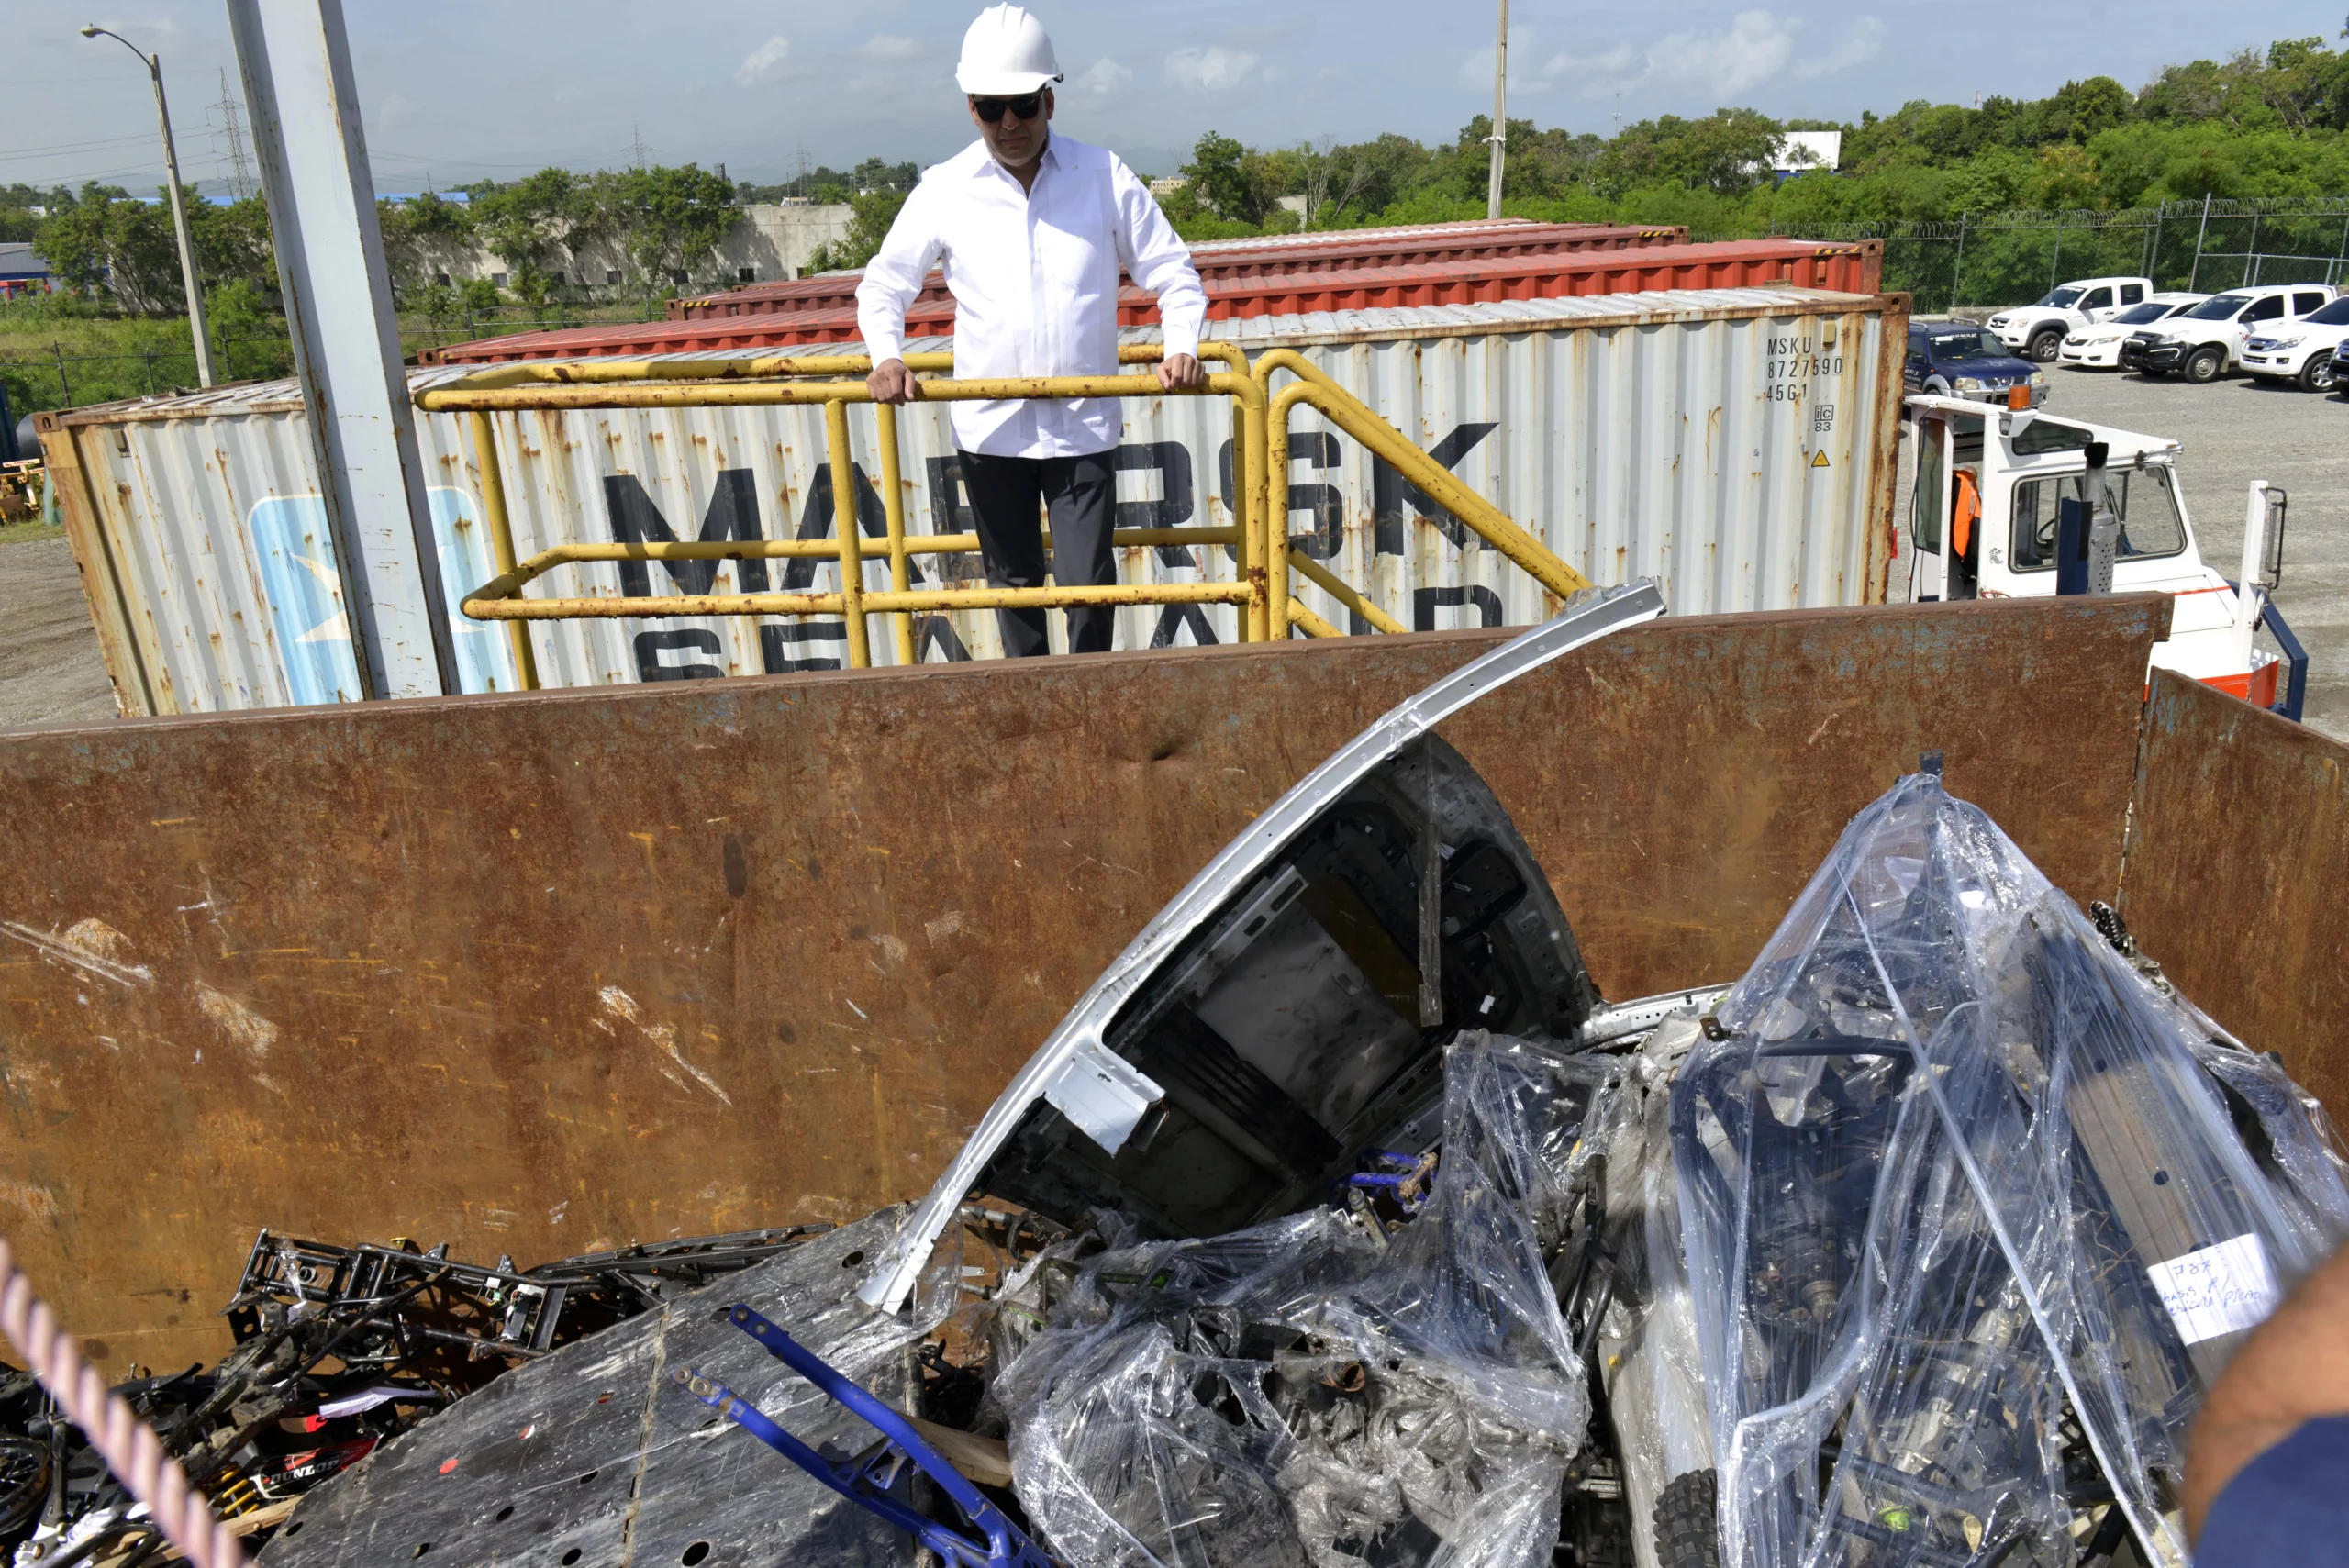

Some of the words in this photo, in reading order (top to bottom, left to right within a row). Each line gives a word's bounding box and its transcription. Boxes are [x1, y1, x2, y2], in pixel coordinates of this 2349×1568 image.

[1767, 337, 1812, 356] MSKU
[1768, 358, 1842, 378] 8727590
[1766, 383, 1807, 403] 45G1
[1814, 422, 1831, 432] 83
[269, 1459, 340, 1485] DUNLOP
